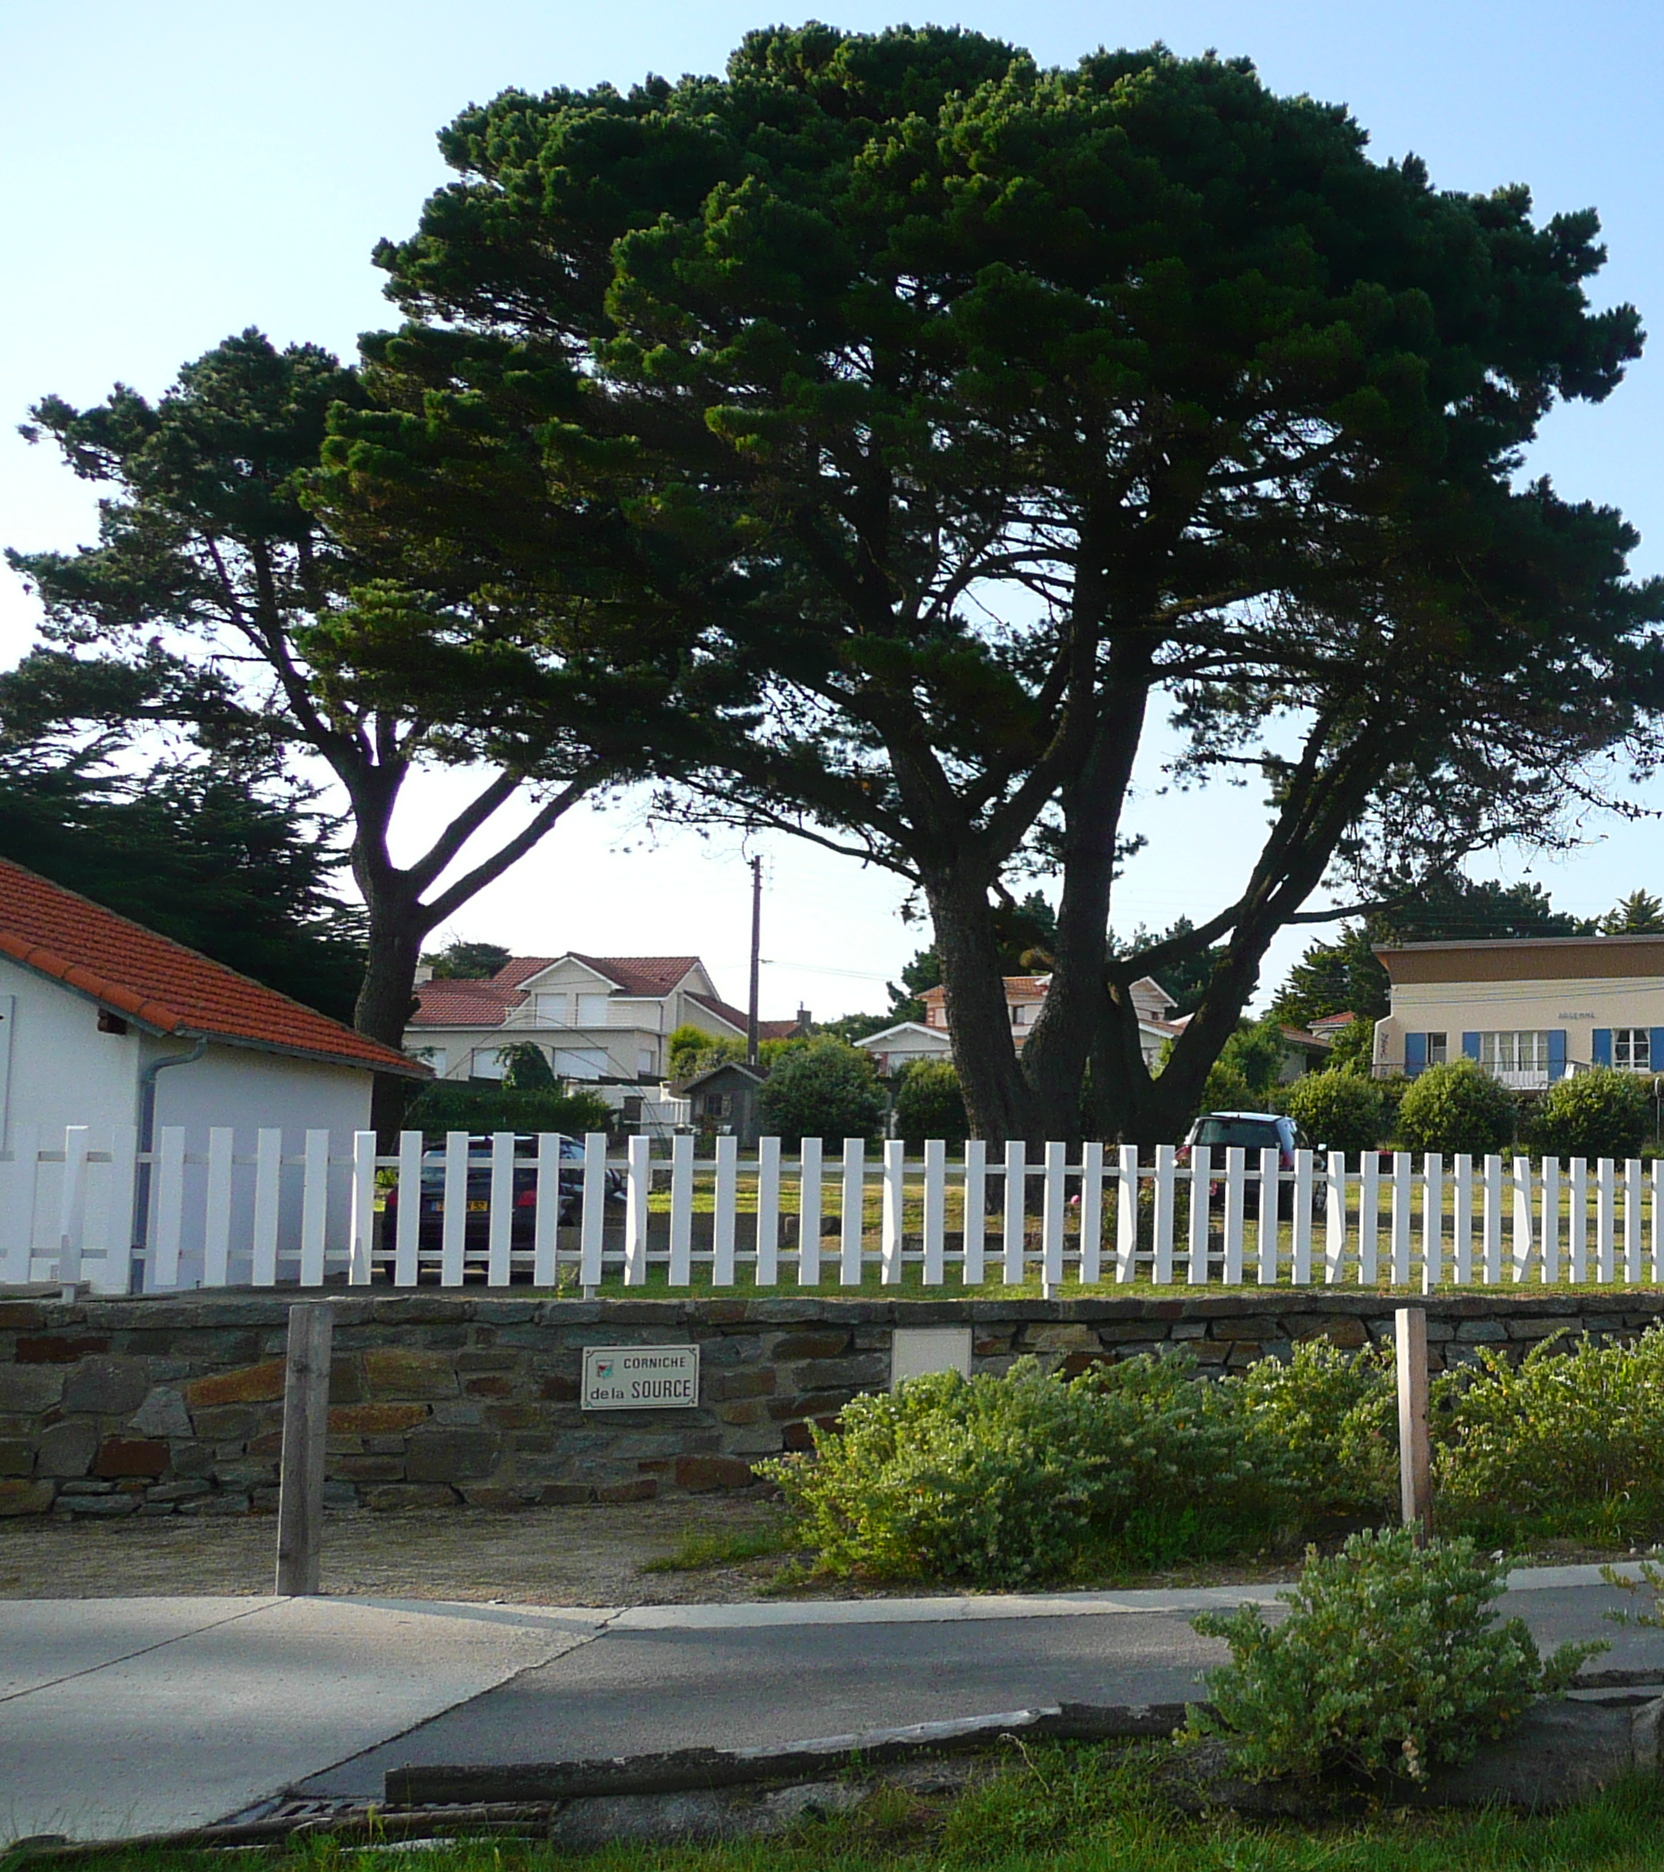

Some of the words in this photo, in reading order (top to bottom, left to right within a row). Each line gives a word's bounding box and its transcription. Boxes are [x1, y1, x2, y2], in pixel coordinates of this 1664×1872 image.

[623, 1357, 686, 1369] CORNICHE
[590, 1388, 609, 1400] de
[611, 1387, 624, 1399] la
[631, 1380, 691, 1399] SOURCE
